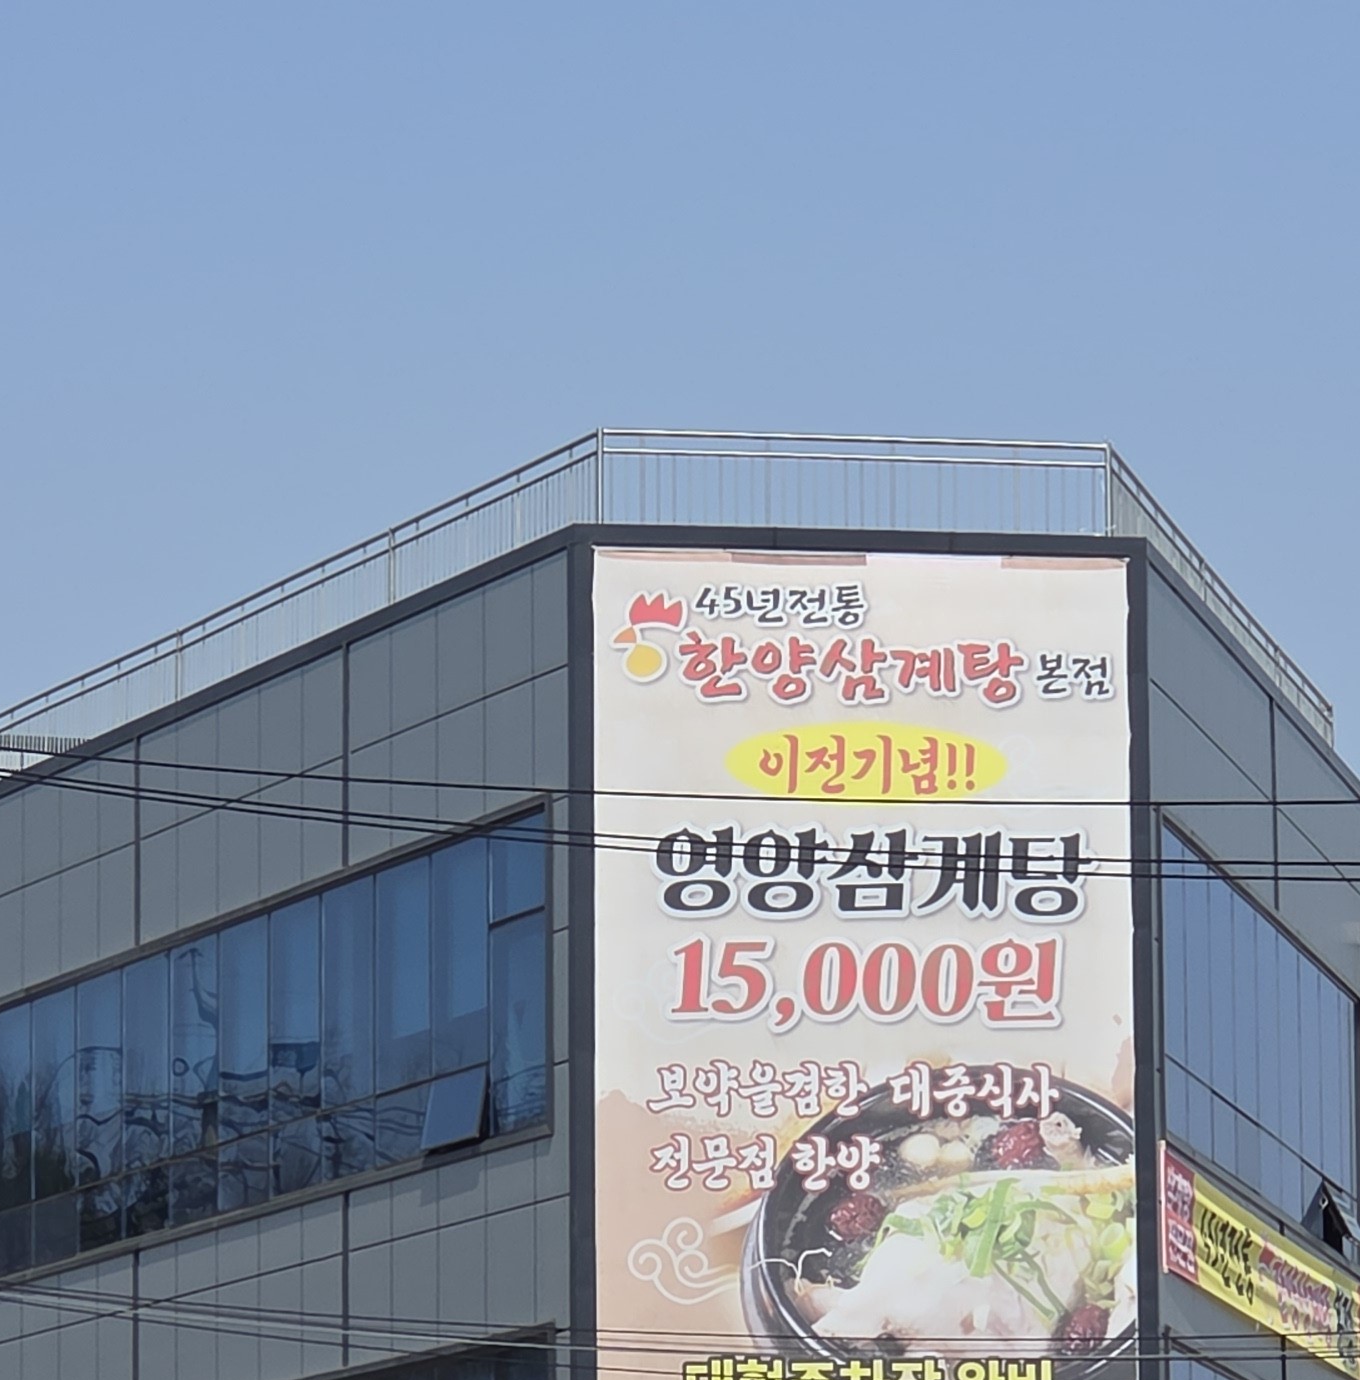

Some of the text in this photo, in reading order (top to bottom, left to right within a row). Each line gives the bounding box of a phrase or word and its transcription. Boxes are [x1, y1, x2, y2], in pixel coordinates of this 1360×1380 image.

[695, 585, 865, 626] 45년전통
[679, 631, 1112, 702] 한양삼계탕 본점
[759, 735, 977, 795] 이전기념!!
[656, 826, 1093, 916] 영양삼계탕
[671, 937, 1057, 1026] 15,000원
[647, 1060, 1059, 1119] 보약을겸한 대중식사
[650, 1135, 881, 1191] 전문점 한양
